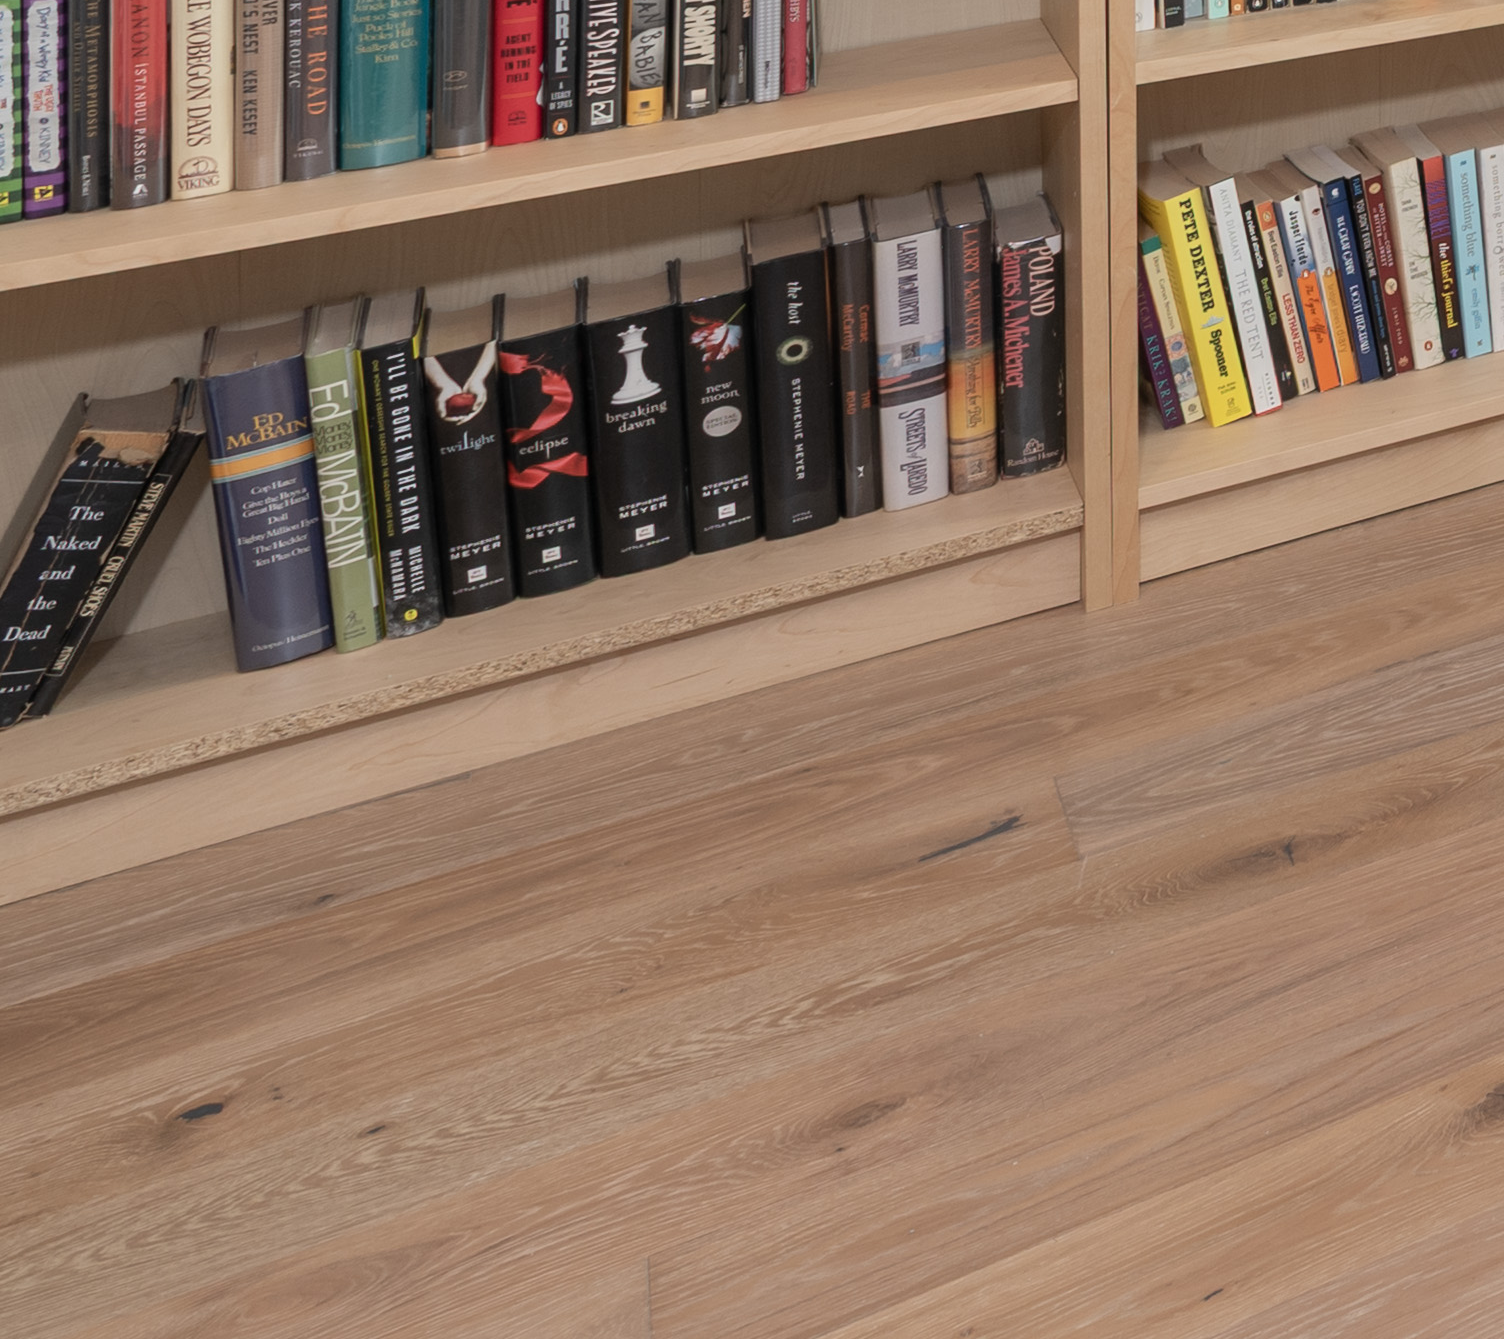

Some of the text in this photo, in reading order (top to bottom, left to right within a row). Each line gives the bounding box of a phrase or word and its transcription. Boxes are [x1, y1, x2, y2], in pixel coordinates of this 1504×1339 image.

[186, 18, 212, 105] WOBEGON
[306, 52, 328, 116] ROAD
[186, 109, 212, 148] DAYS
[1179, 199, 1215, 313] PETE DEXTER
[1208, 328, 1229, 378] Spooner
[605, 400, 668, 426] breaking
[618, 416, 656, 433] dawn
[440, 432, 495, 457] twilight
[69, 506, 105, 523] The
[40, 535, 101, 551] Naked
[39, 567, 75, 582] and
[27, 597, 58, 612] the
[2, 626, 52, 642] Dead
